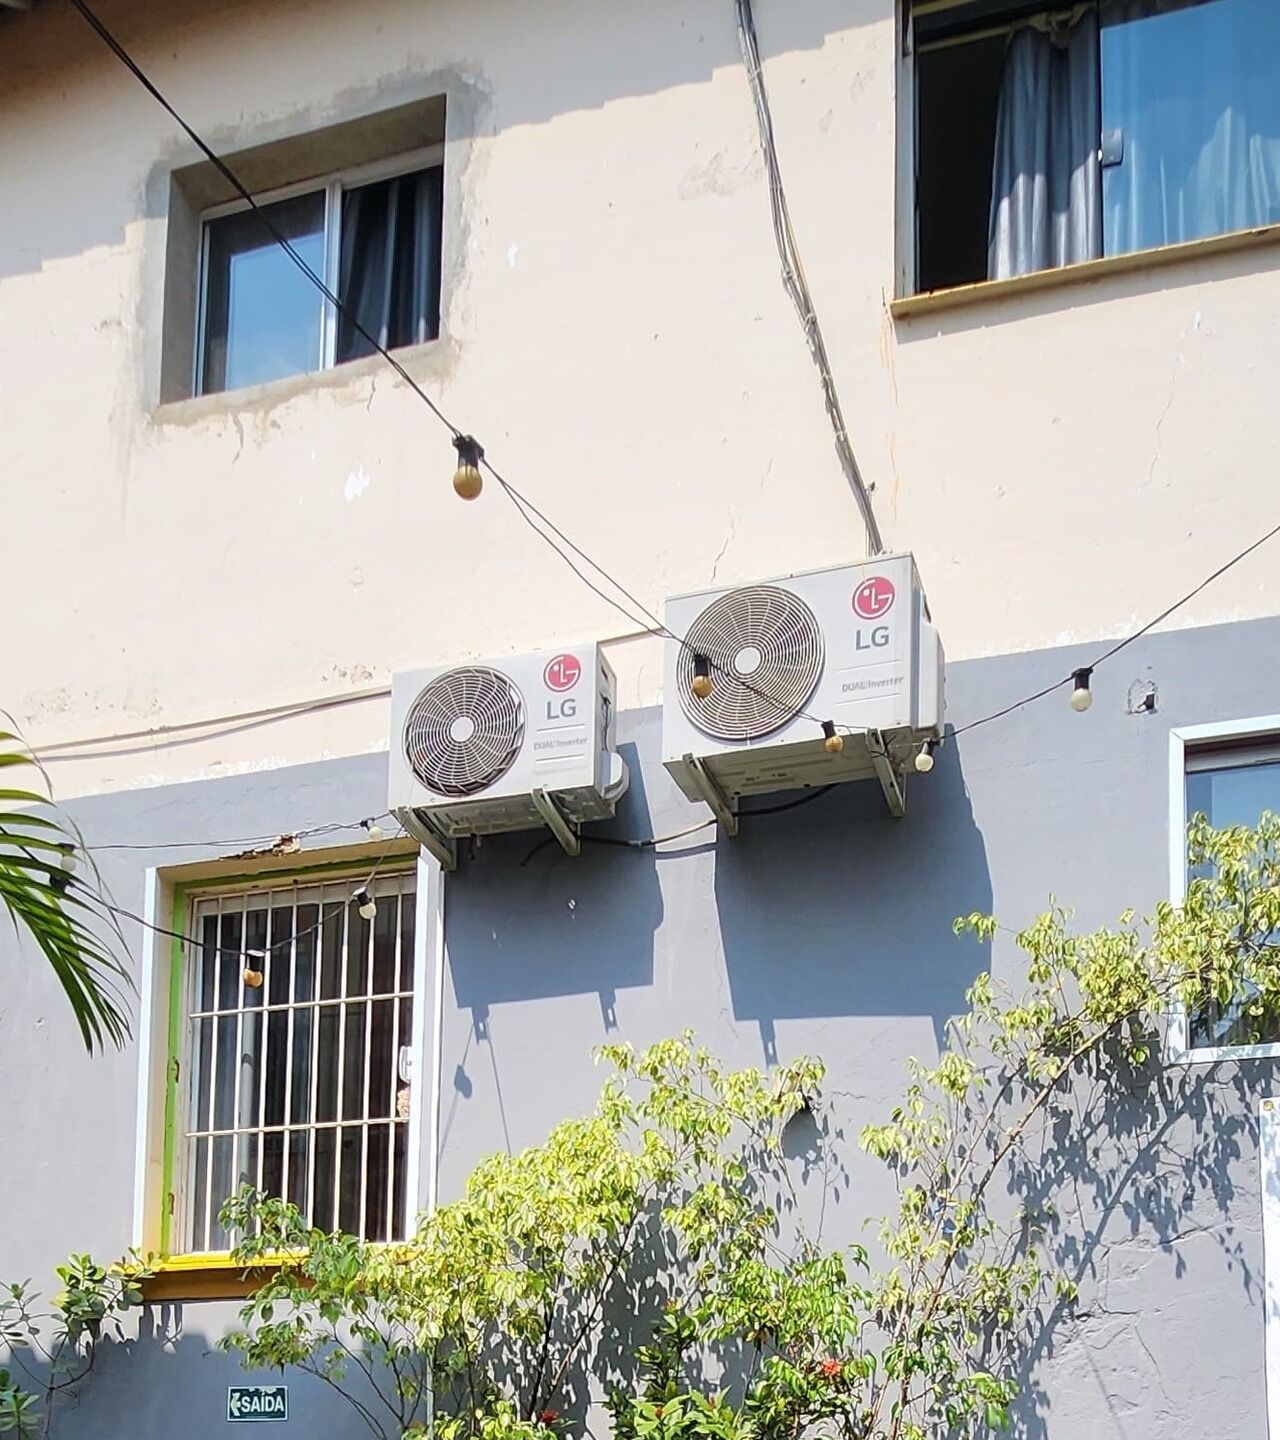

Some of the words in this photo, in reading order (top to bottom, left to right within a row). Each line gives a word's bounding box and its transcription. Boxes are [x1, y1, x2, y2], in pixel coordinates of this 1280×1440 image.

[855, 626, 889, 651] LG
[546, 698, 577, 720] LG
[241, 1392, 284, 1412] SAÍDA
